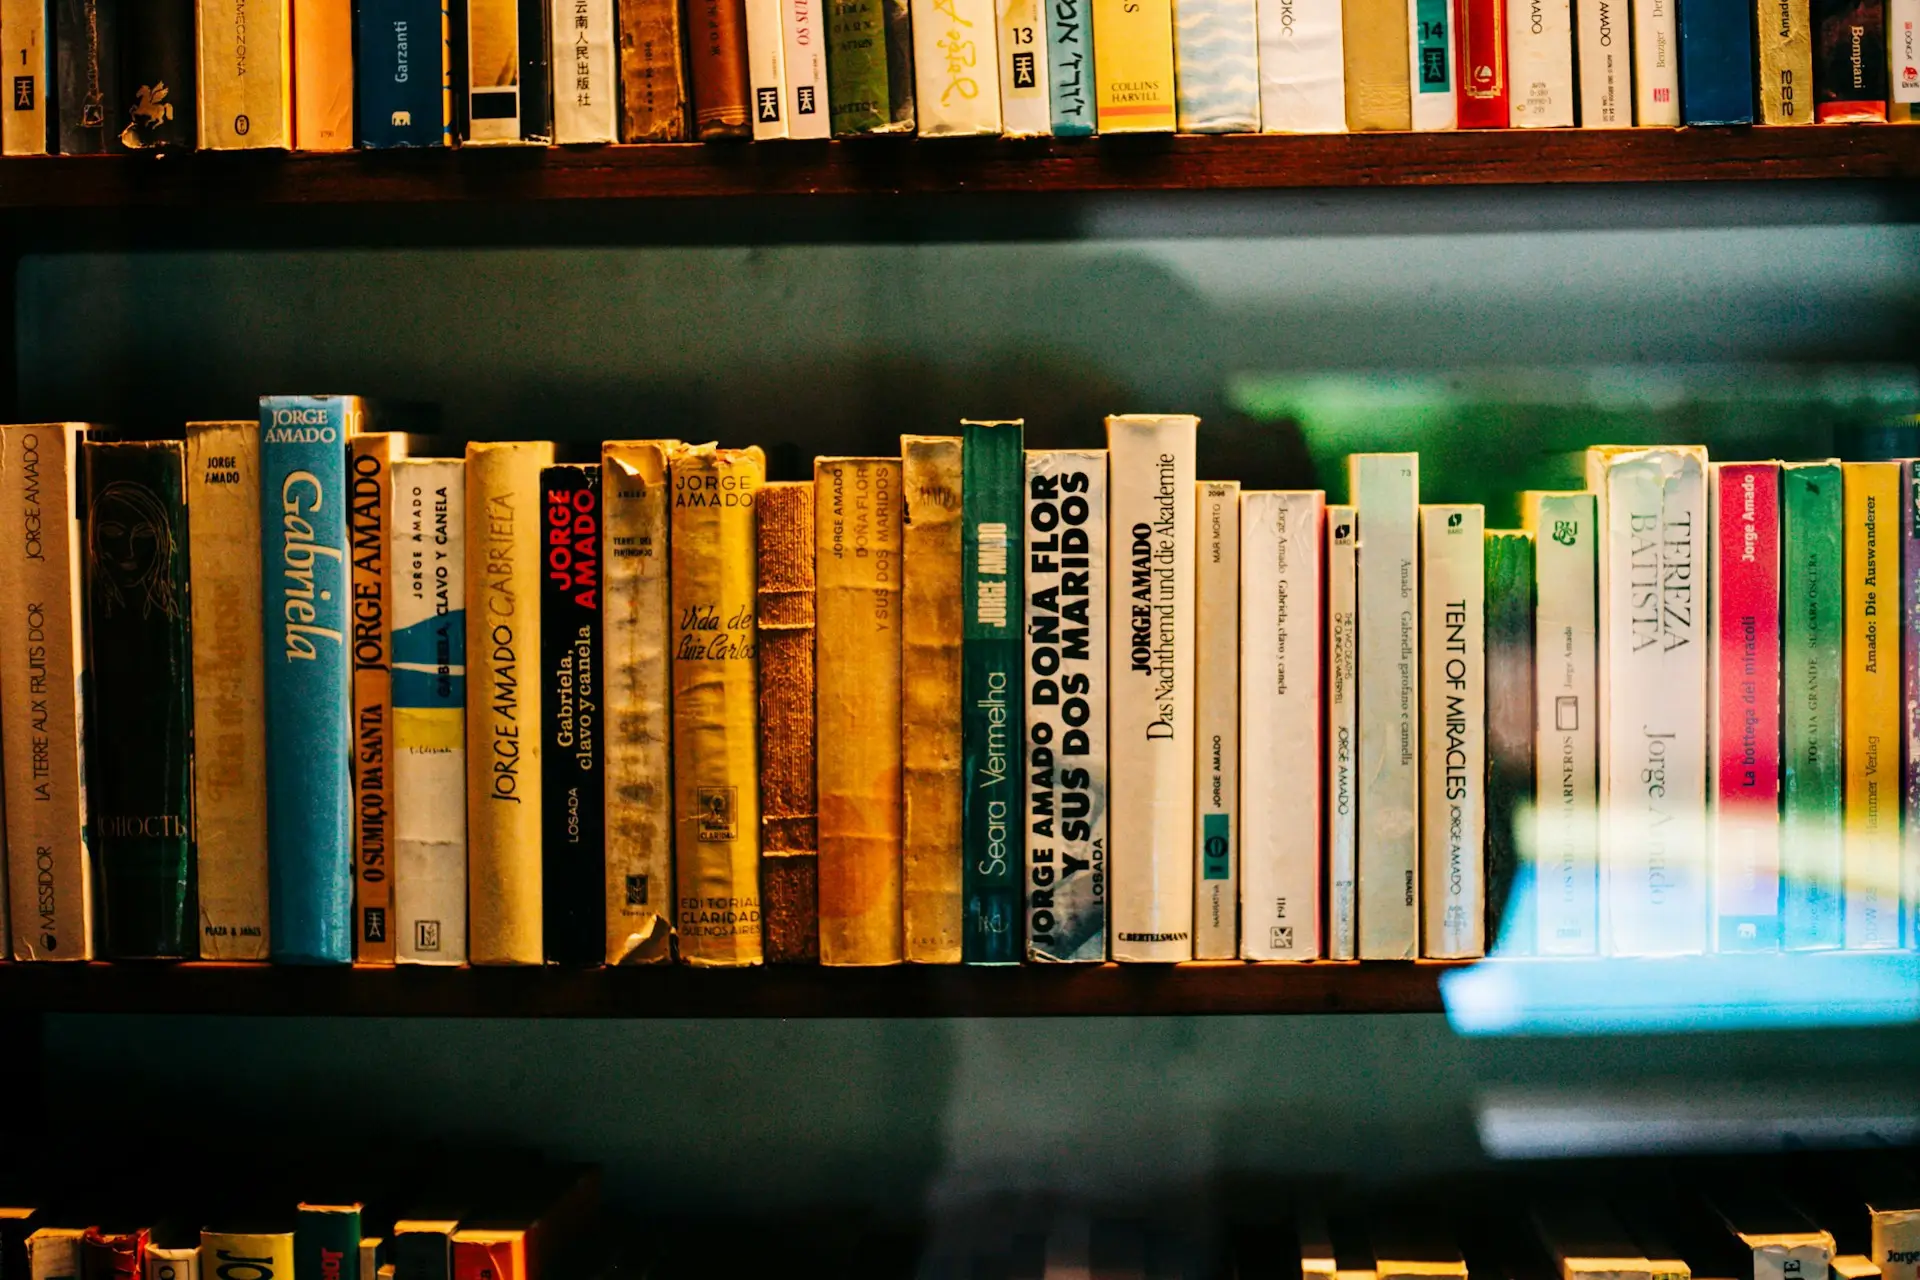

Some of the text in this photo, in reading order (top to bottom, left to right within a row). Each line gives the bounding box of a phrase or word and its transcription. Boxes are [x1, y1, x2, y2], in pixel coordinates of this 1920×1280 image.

[236, 0, 247, 76] MĘCZONA
[796, 28, 810, 46] OS
[1012, 27, 1034, 45] 13
[1422, 21, 1445, 40] 14
[1600, 1, 1612, 47] AMADO
[394, 20, 409, 83] Garzanti
[1655, 31, 1667, 69] Benziger
[1850, 26, 1867, 89] Bompiani
[1111, 80, 1159, 91] COLLINS
[1111, 91, 1160, 103] HARVILL
[264, 426, 337, 444] AMADO
[271, 408, 329, 429] JORGE
[204, 471, 240, 485] AMADO
[207, 456, 237, 469] JORGE
[675, 475, 752, 491] JORGE
[22, 433, 45, 563] JORGE AMADO
[434, 486, 448, 545] CANELA
[675, 492, 754, 508] AMADO
[833, 468, 846, 560] JORGE AMADO
[853, 467, 870, 559] DOÑA FLOR
[1212, 503, 1221, 539] MORTO
[1277, 507, 1289, 534] Jorge
[1741, 474, 1759, 563] Jorge Amado
[352, 454, 390, 673] JORGE AMADO
[411, 486, 424, 600] JORGE AMADO
[434, 550, 447, 561] Y
[547, 489, 572, 591] JORGE
[573, 489, 597, 610] AMADO
[875, 467, 890, 633] Y SUS DOS MARIDOS
[1212, 542, 1221, 564] MAR
[1278, 536, 1289, 574] Amado
[282, 470, 343, 664] Gabriela
[434, 567, 449, 617] CLAVO
[977, 523, 1007, 628] JORGE AMADO
[1400, 559, 1411, 598] Amado
[1631, 512, 1660, 653] BATISTA
[1663, 511, 1692, 653] TEREZA
[1808, 553, 1818, 599] OSCURA
[1864, 495, 1877, 674] Amado: Die Auswanderer
[680, 604, 753, 631] Vida de
[1131, 522, 1152, 677] JORGE AMADO
[1145, 453, 1175, 741] Das Nachthemd und die Akademie
[1334, 612, 1344, 624] OF
[1808, 602, 1818, 631] CARA
[487, 491, 521, 805] JORGE AMADO GABRIELA
[675, 633, 757, 661] Luiz Carlos
[1278, 627, 1289, 653] clavo
[1333, 626, 1344, 664] QUINCAS
[1343, 612, 1353, 680] THE TWO DEATHS
[1400, 611, 1412, 661] Gabriella
[1741, 616, 1756, 676] miracoli
[556, 649, 575, 748] Gabriela,
[576, 625, 595, 770] clavo y canela
[1060, 471, 1091, 879] Y SUS DOS MARIDOS
[1278, 662, 1289, 695] canela
[1397, 662, 1412, 711] garofano
[1445, 599, 1467, 800] TENT OF MIRACLES
[27, 602, 52, 801] LA TERRE AUX FRUITS D'OR
[1028, 473, 1060, 947] JORGE AMADO DOÑA FLOR
[1807, 658, 1818, 764] TOCAIA GRANDE
[360, 703, 384, 764] SANTA
[1212, 735, 1221, 772] AMADO
[1400, 721, 1413, 766] cannella
[1741, 708, 1758, 766] bottega
[1865, 735, 1880, 777] Verlag
[361, 765, 384, 791] DA
[977, 672, 1007, 877] Seara Vermelha
[1337, 726, 1350, 816] JORGE AMADO
[1640, 724, 1677, 799] Jorge
[1742, 770, 1756, 787] La
[567, 787, 579, 843] LOSADA
[1212, 774, 1222, 808] JORGE
[361, 793, 388, 866] SUMIÇO
[1449, 803, 1462, 895] JORGE AMADO
[36, 846, 56, 930] MESSIDOR
[362, 869, 385, 883] O
[1092, 837, 1105, 906] LOSADA
[1405, 869, 1413, 907] EINAUDI
[681, 897, 761, 910] EDITORIAL
[681, 911, 760, 925] CLARIDAD
[681, 925, 761, 937] BUENOS AIRES
